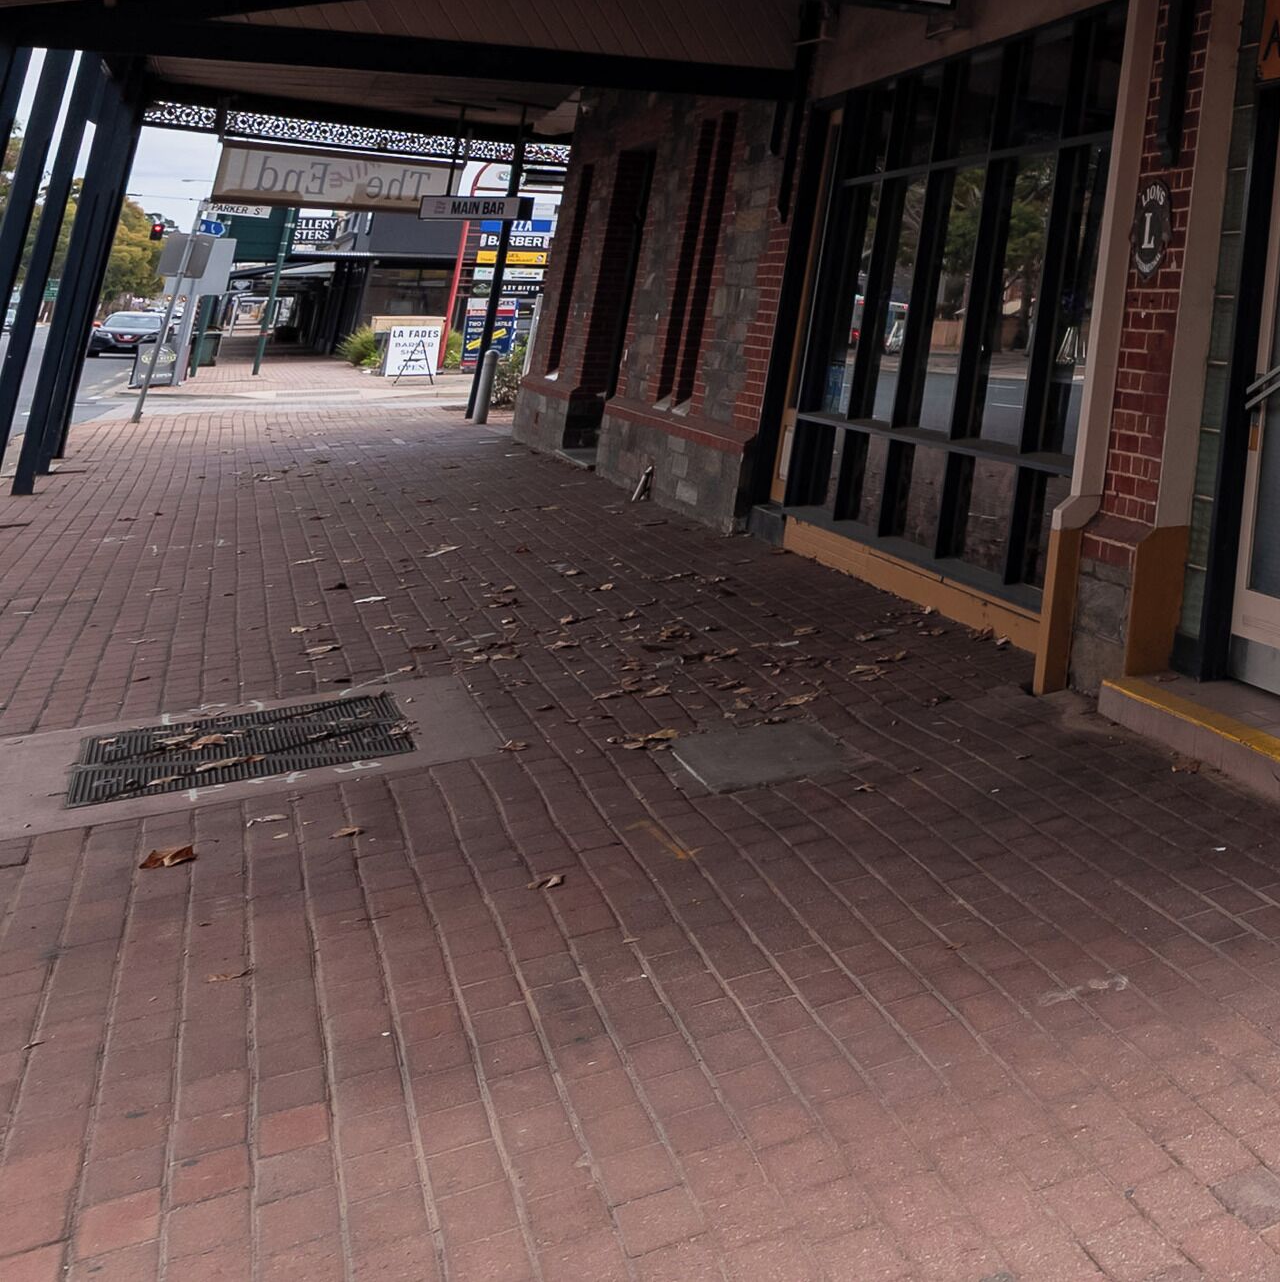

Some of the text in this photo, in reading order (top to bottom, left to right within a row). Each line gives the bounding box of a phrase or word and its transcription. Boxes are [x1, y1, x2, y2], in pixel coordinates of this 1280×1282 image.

[1141, 185, 1166, 207] LIONS
[211, 203, 248, 214] PARKER
[451, 201, 479, 215] MAIN
[482, 201, 505, 215] BAR
[296, 219, 337, 229] ELLERY
[294, 229, 330, 240] STERS
[1141, 212, 1154, 249] L
[487, 235, 542, 247] BRBER
[393, 330, 439, 338] LA FADES
